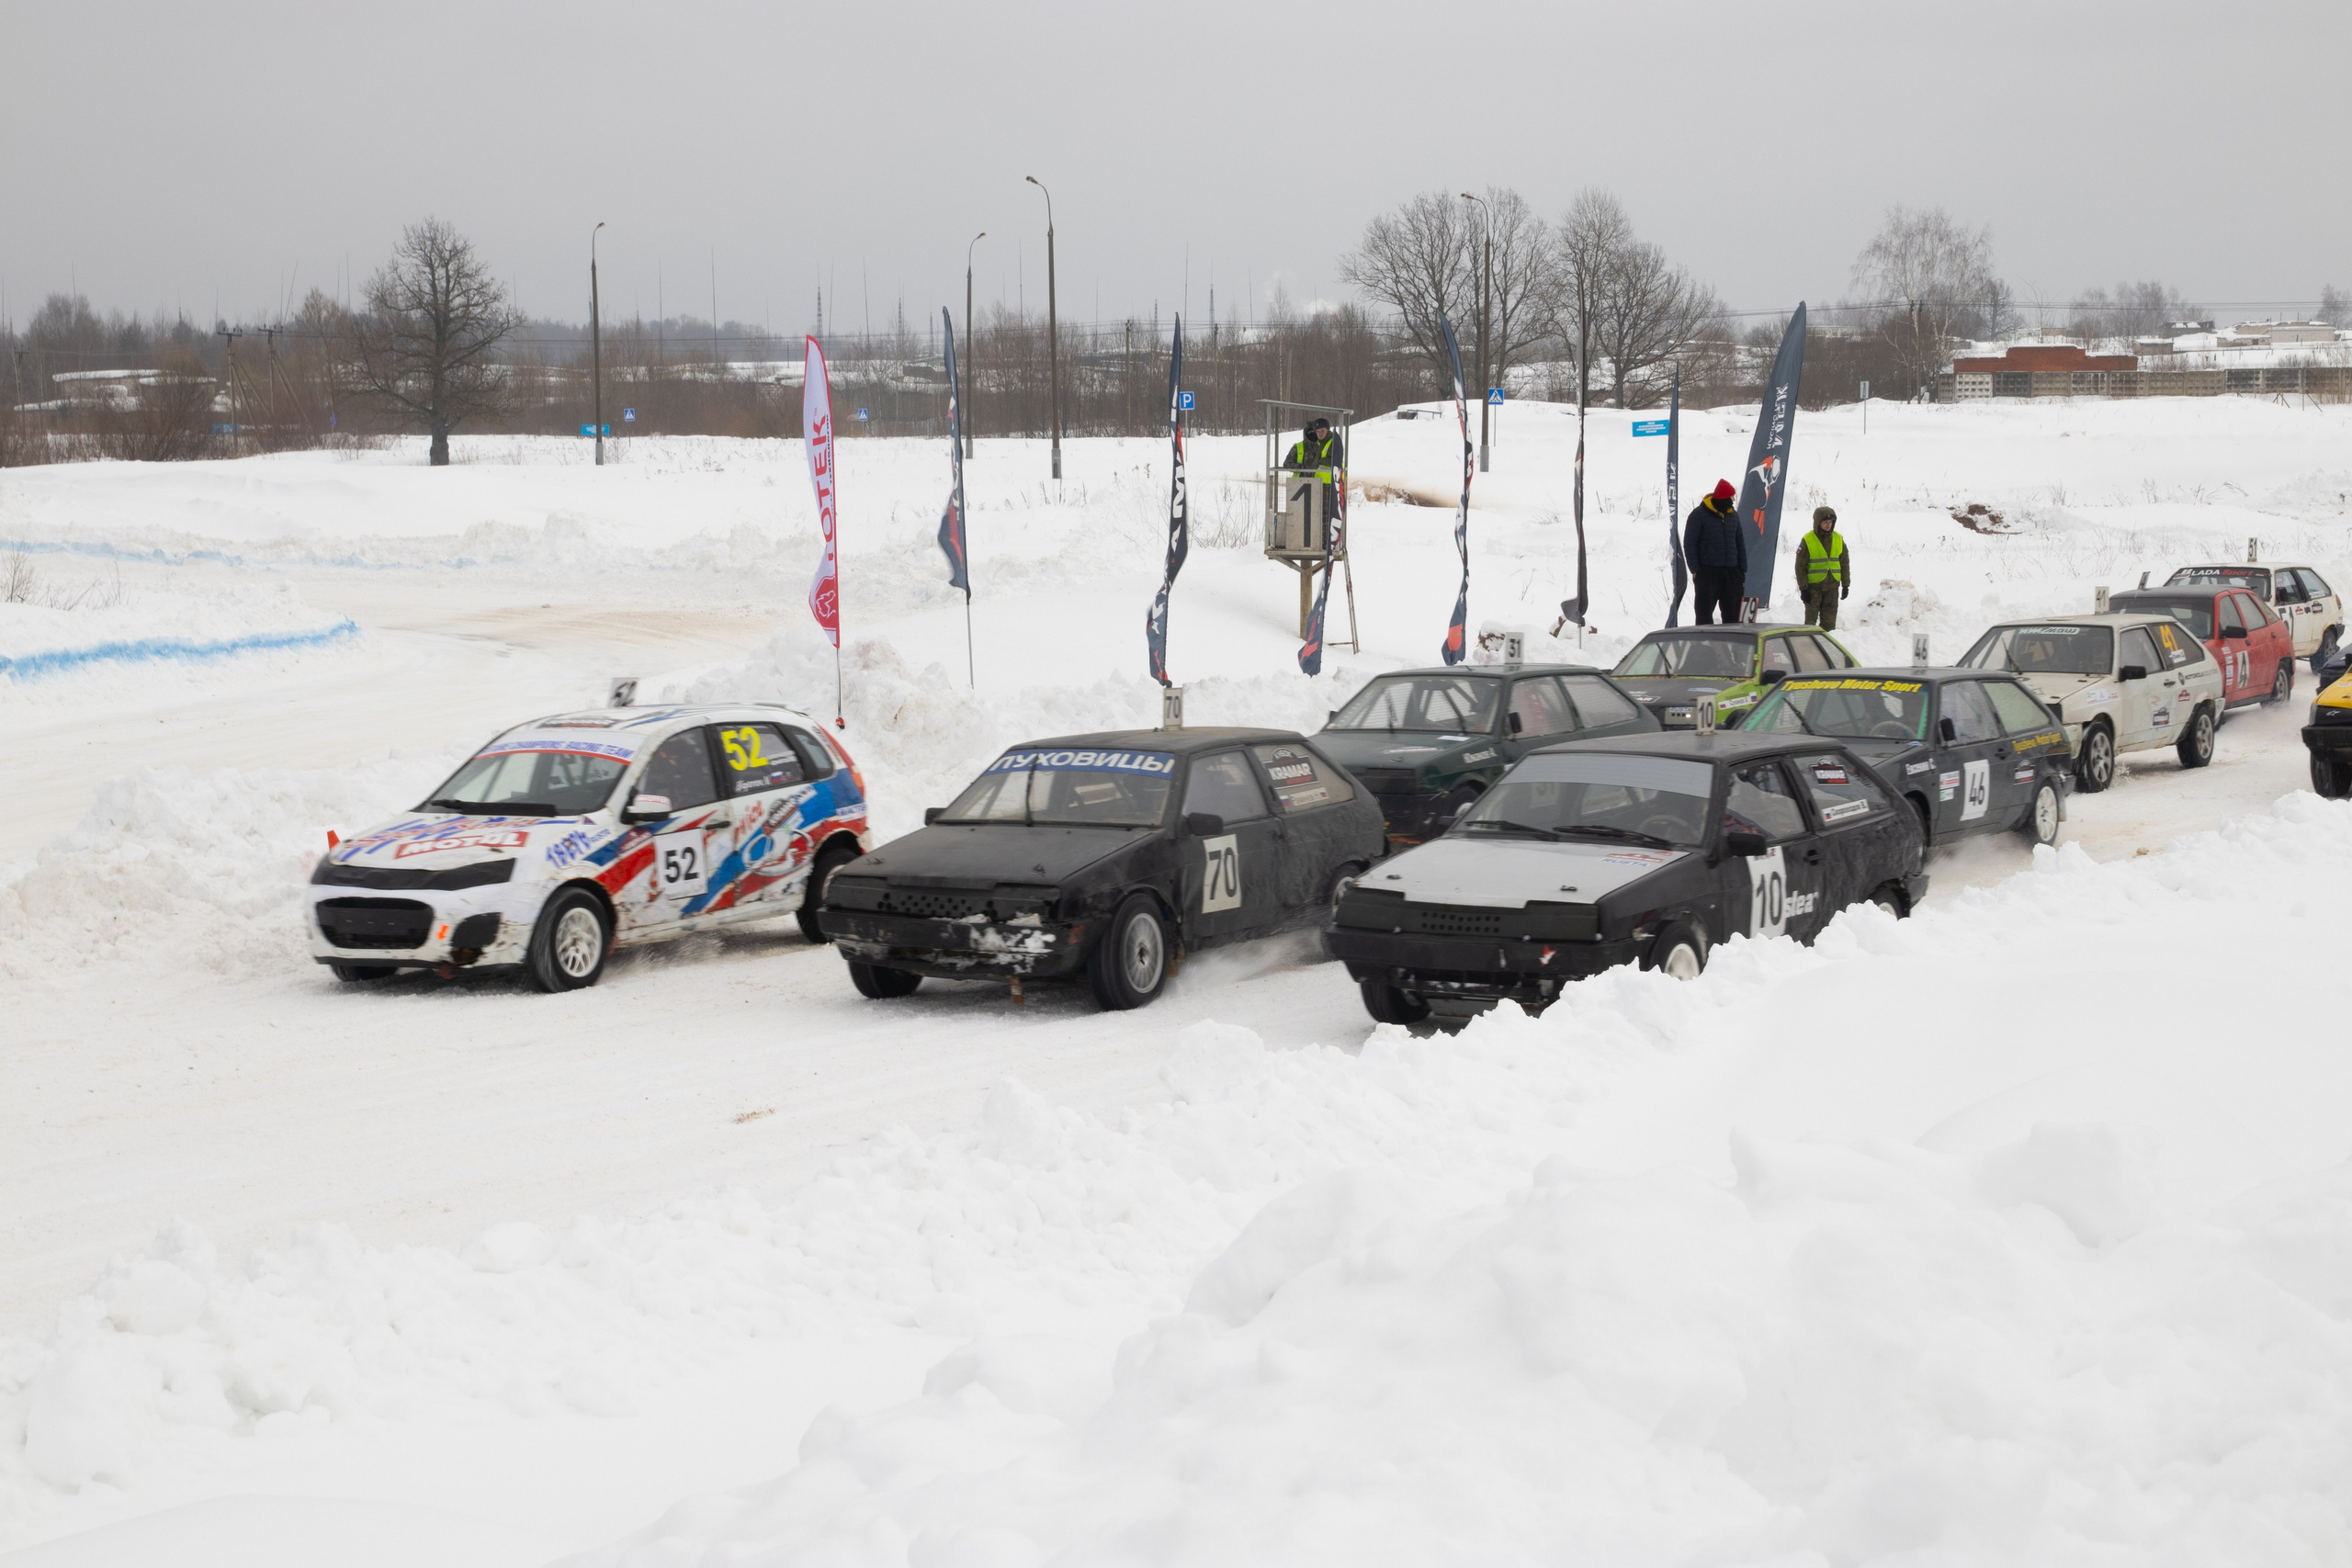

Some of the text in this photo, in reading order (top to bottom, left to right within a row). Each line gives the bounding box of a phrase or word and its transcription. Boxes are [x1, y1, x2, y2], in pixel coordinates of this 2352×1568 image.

[1182, 393, 1192, 408] P
[1290, 483, 1312, 547] 1
[2248, 537, 2257, 558] 51
[2191, 569, 2220, 577] LADA
[2222, 569, 2254, 577] Sport
[1742, 597, 1757, 623] 79
[2097, 589, 2106, 608] 41
[1509, 638, 1521, 659] 31
[1915, 638, 1928, 660] 46
[2159, 624, 2178, 652] 41
[2239, 652, 2247, 687] 4
[613, 681, 637, 707] 52
[1781, 679, 1922, 693] Tyushevo Motor Sport
[1165, 695, 1181, 719] 70
[1699, 701, 1713, 728] 10
[720, 727, 770, 771] 52
[989, 751, 1176, 773] ЛУХОВИЦЫ
[1268, 762, 1313, 781] KRAMAR
[1969, 772, 1985, 807] 46
[404, 831, 522, 857] MOTUL
[665, 847, 700, 884] 52
[1208, 847, 1238, 900] 70
[1756, 871, 1783, 929] 10
